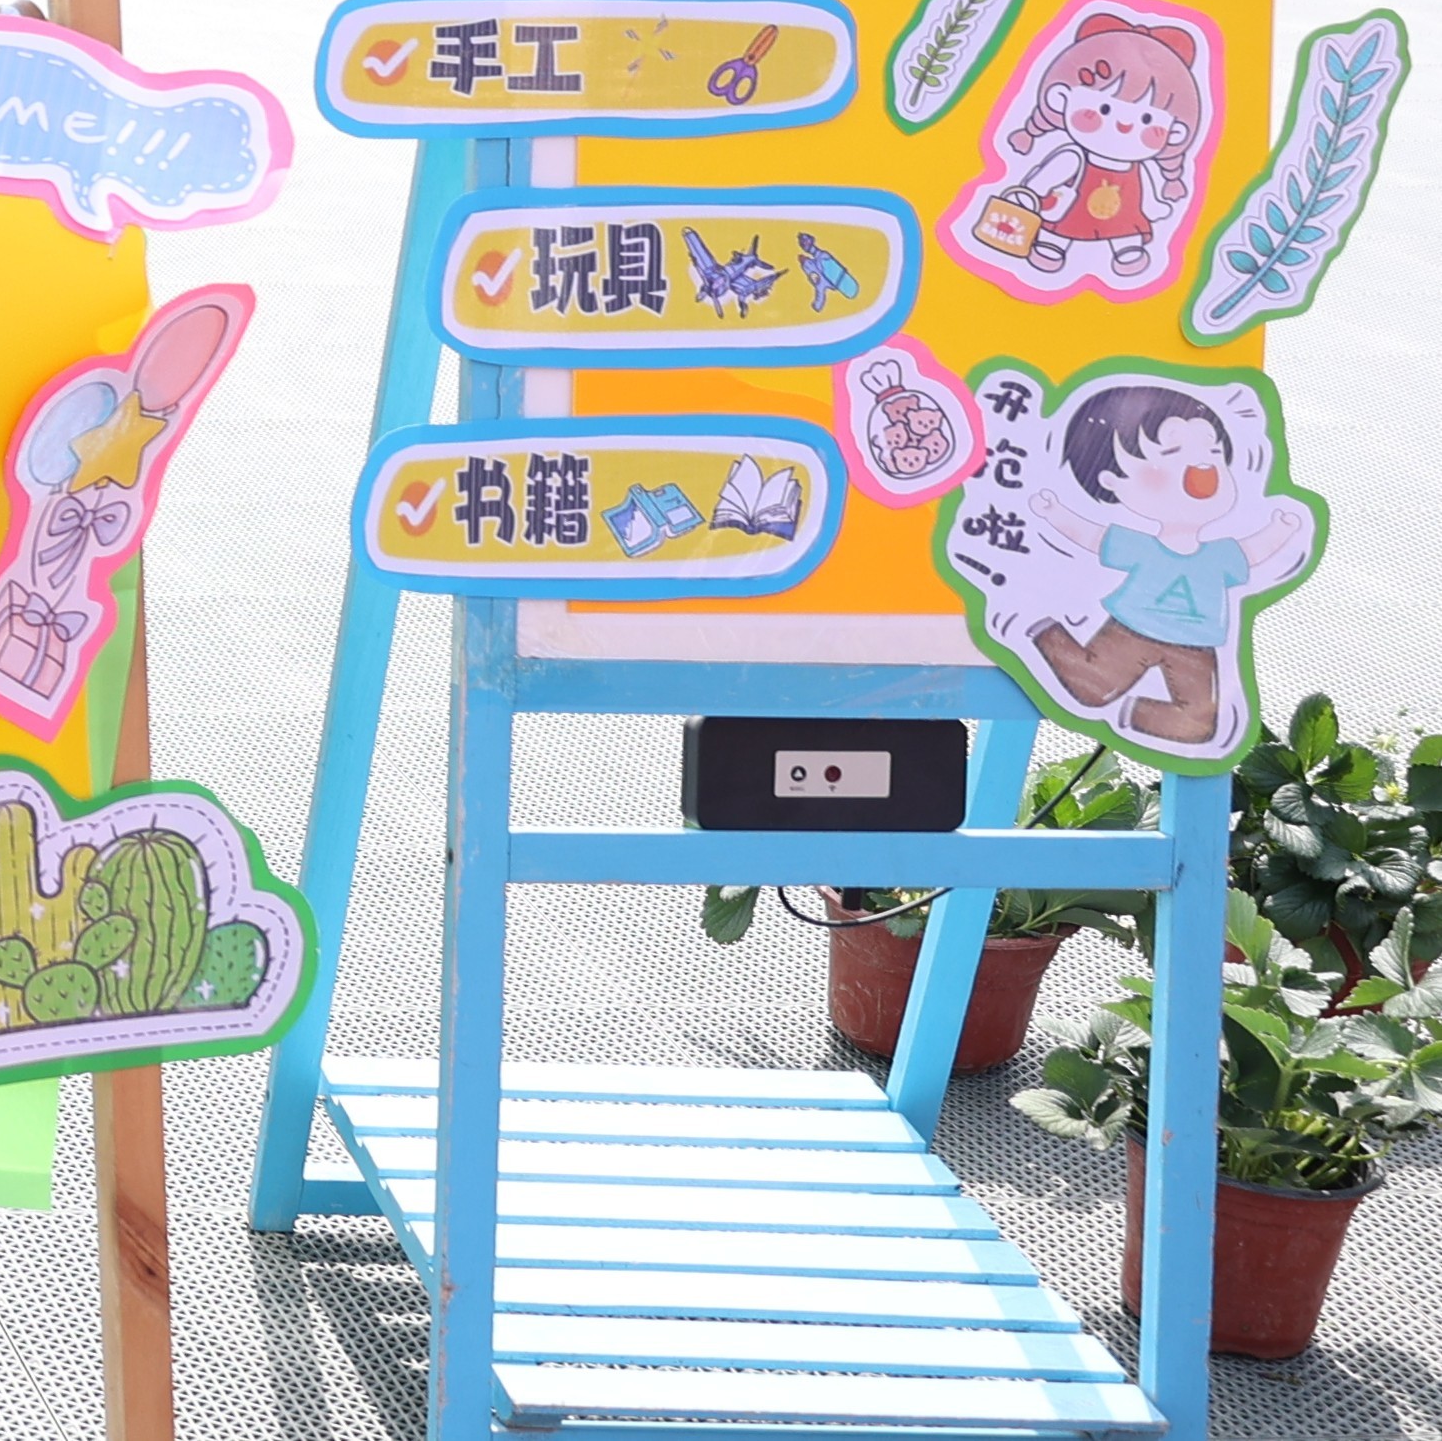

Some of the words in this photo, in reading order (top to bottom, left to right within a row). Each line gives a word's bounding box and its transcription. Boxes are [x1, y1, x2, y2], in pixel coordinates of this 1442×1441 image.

[427, 16, 583, 99] 手工
[529, 223, 669, 318] 玩具
[454, 452, 592, 548] 书籍
